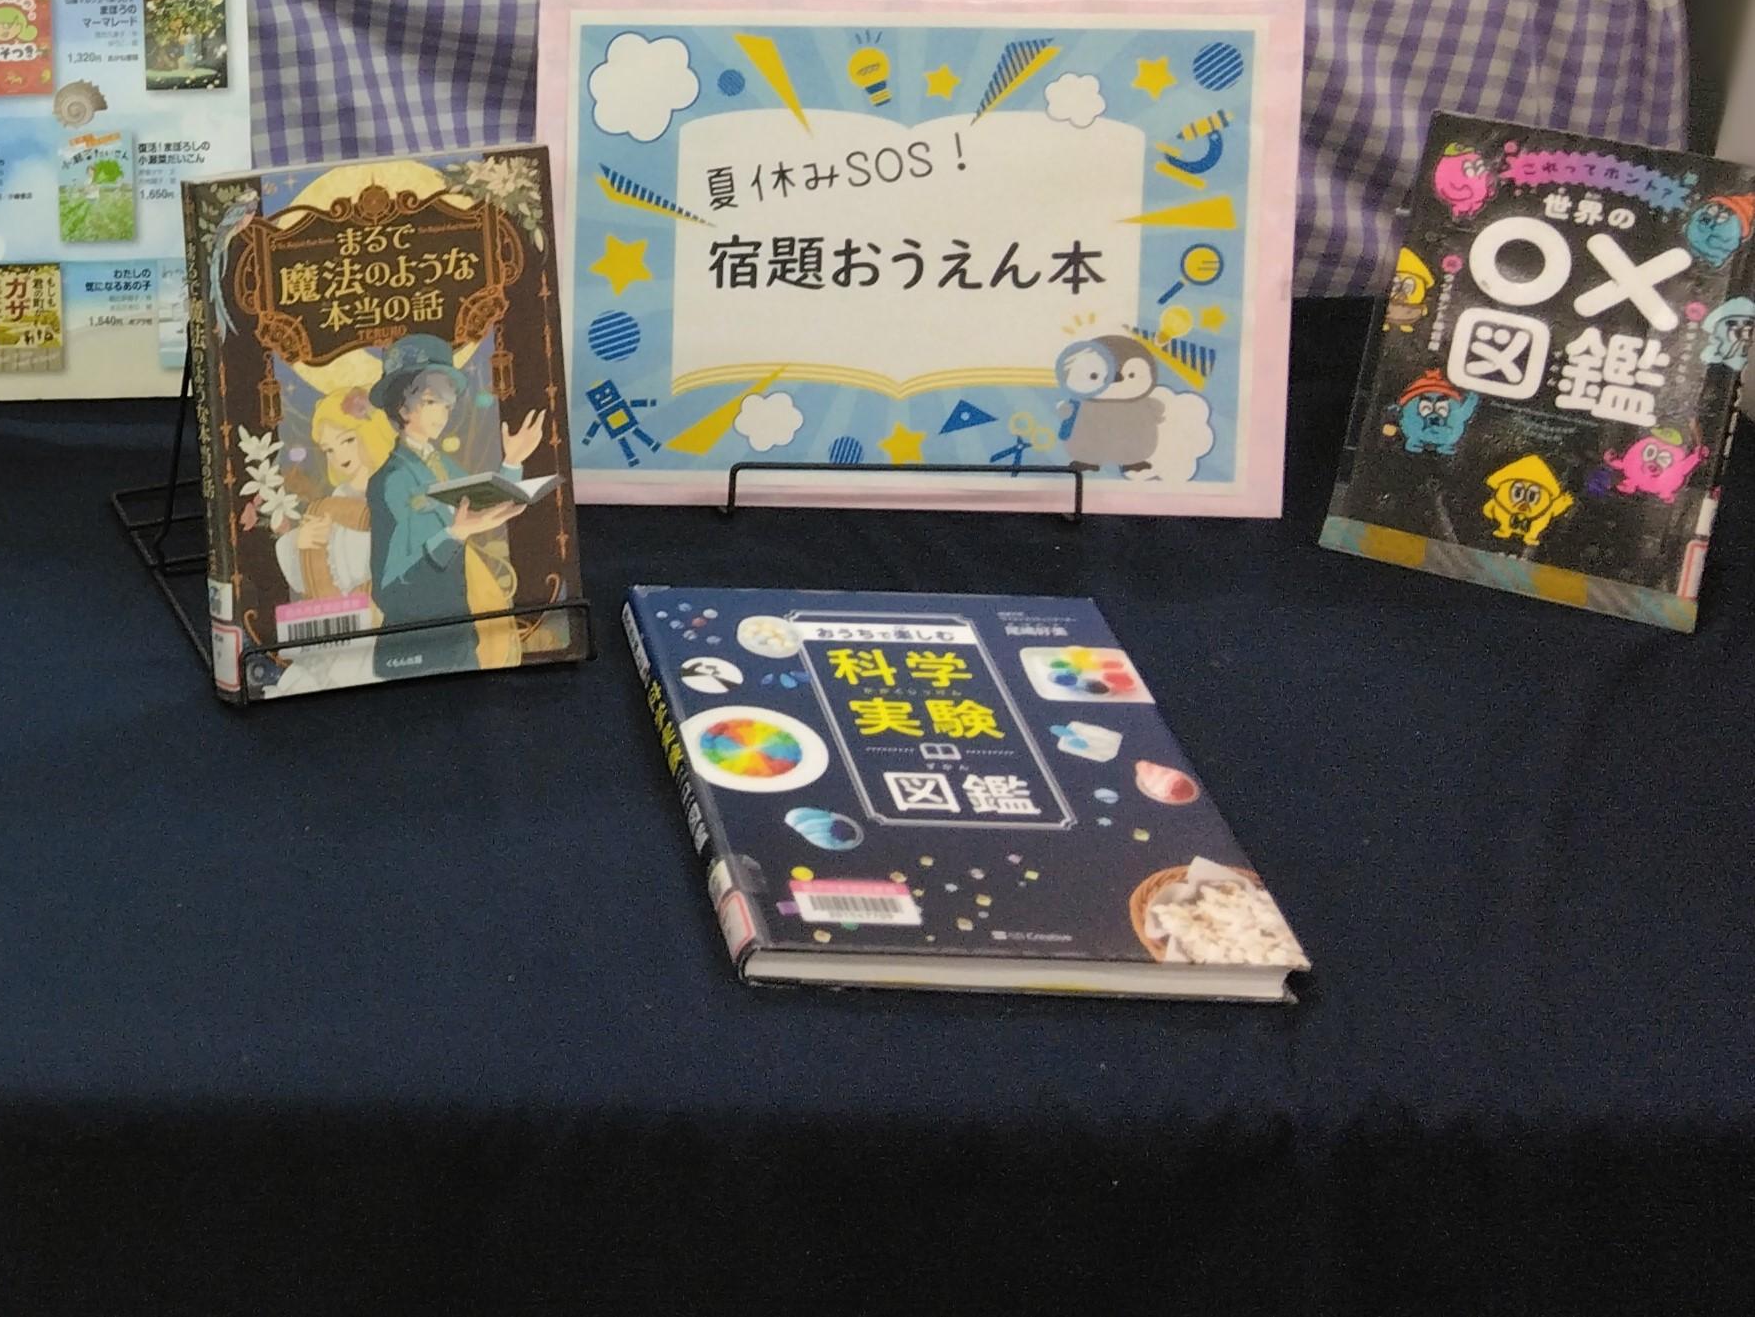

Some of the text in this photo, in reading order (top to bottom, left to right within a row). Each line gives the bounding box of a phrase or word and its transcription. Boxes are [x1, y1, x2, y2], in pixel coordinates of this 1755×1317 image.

[705, 131, 970, 211] 夏休みSOS！
[1542, 193, 1637, 231] 世界の
[337, 223, 416, 256] まるで
[279, 246, 480, 306] 魔法のような
[707, 234, 1110, 295] 宿題おうえん本
[319, 288, 445, 333] 本当の話
[1446, 307, 1671, 429] 図鑑
[826, 648, 974, 688] 科学
[848, 696, 1007, 739] 実験
[883, 770, 1043, 815] 図鑑
